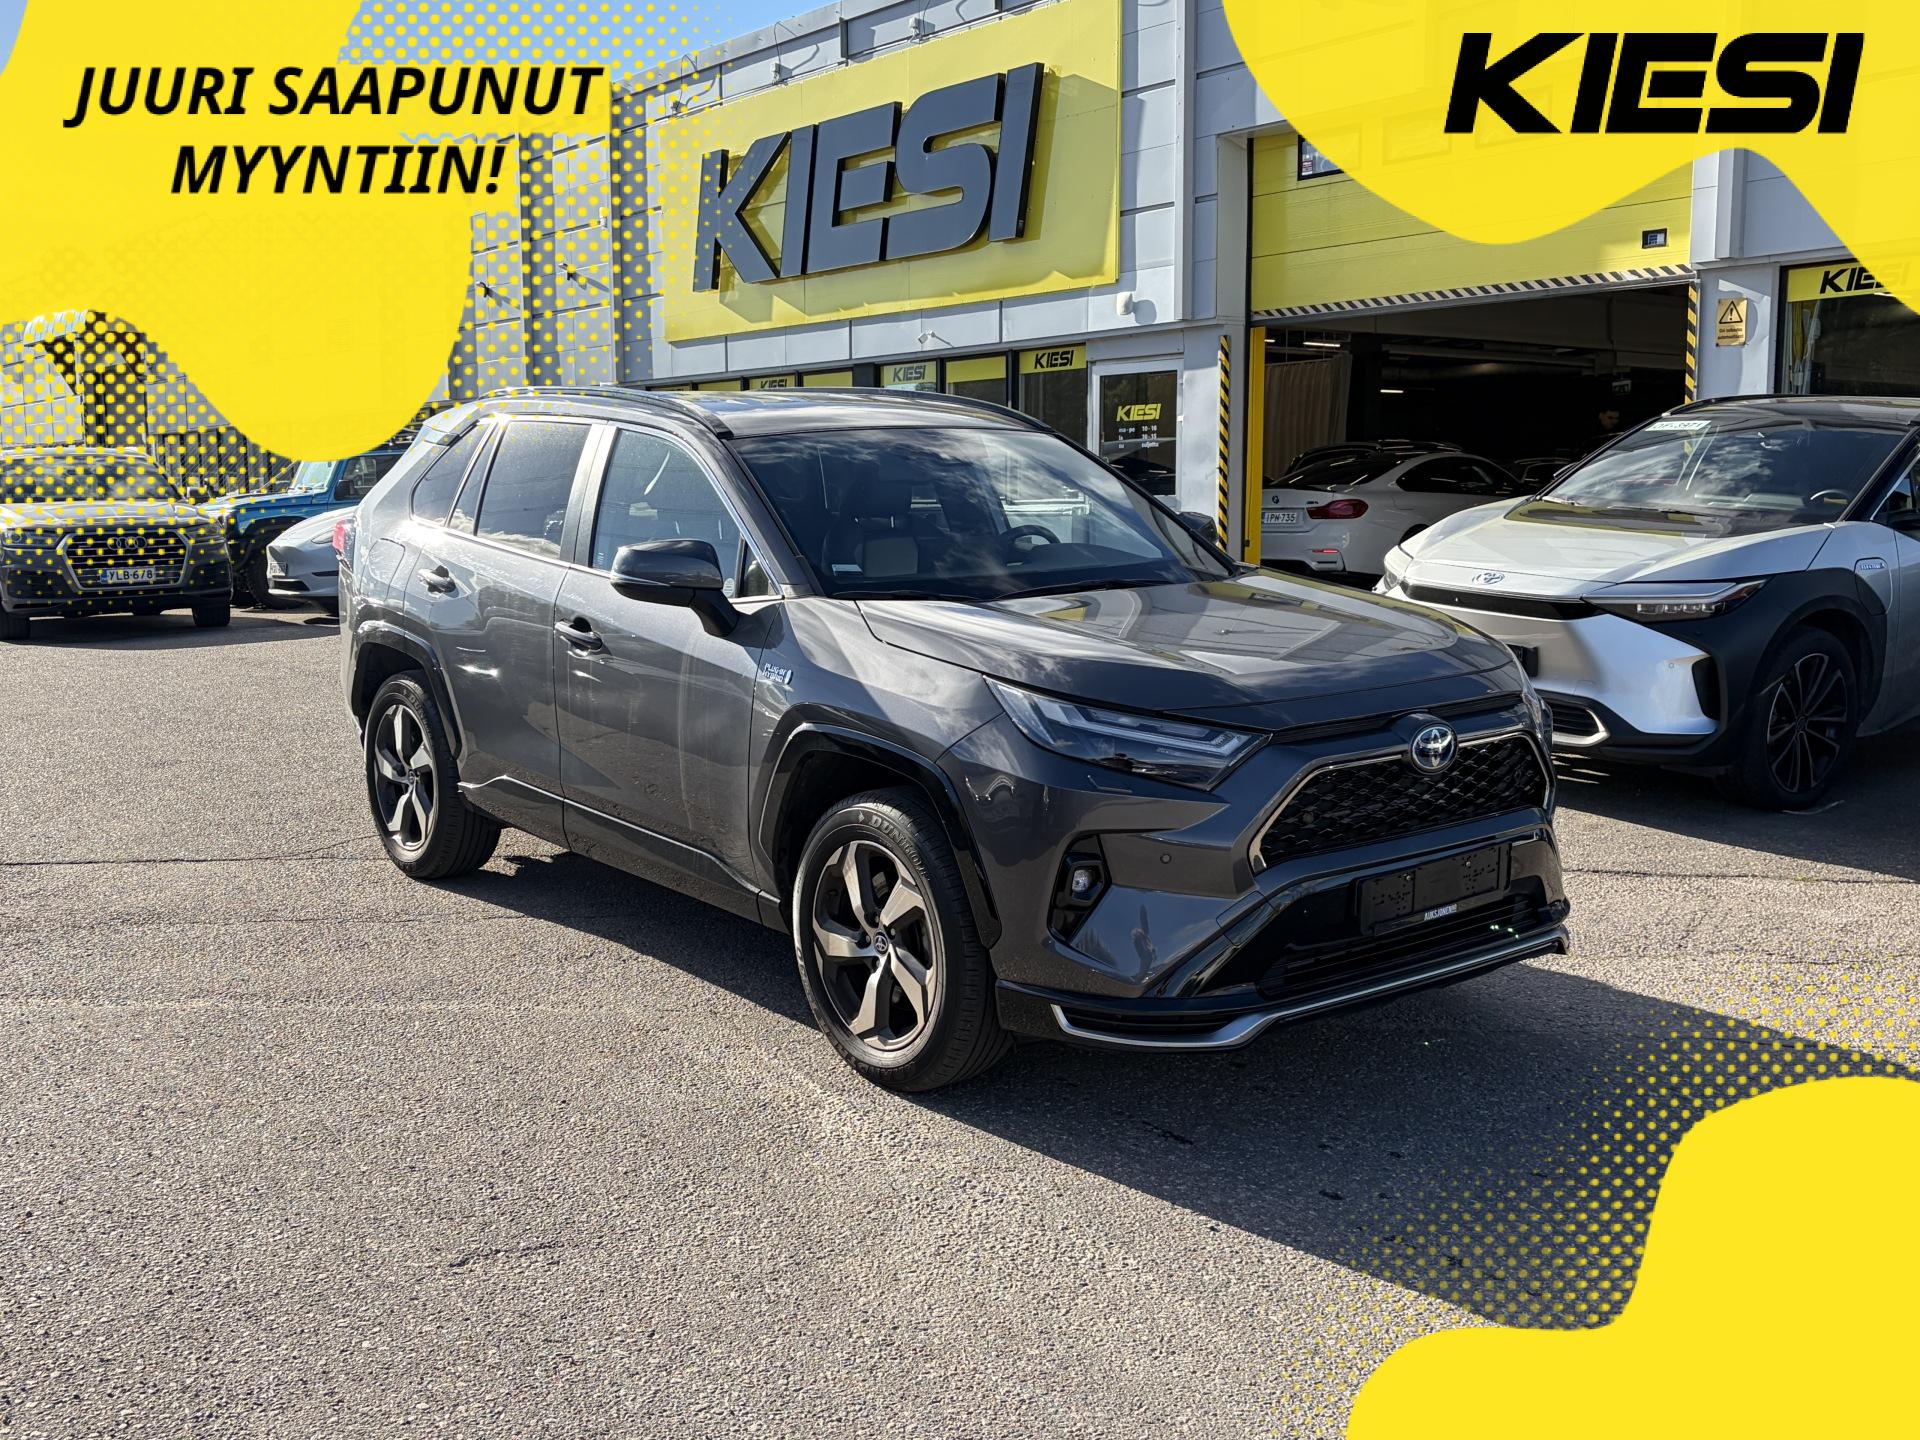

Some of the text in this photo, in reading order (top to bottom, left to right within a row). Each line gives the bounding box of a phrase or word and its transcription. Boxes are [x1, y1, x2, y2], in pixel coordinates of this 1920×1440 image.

[693, 62, 1044, 292] KIESI
[1820, 266, 1885, 294] KIE
[1034, 350, 1074, 369] KIESI
[893, 364, 926, 382] KIESI
[1116, 403, 1162, 421] KIESI
